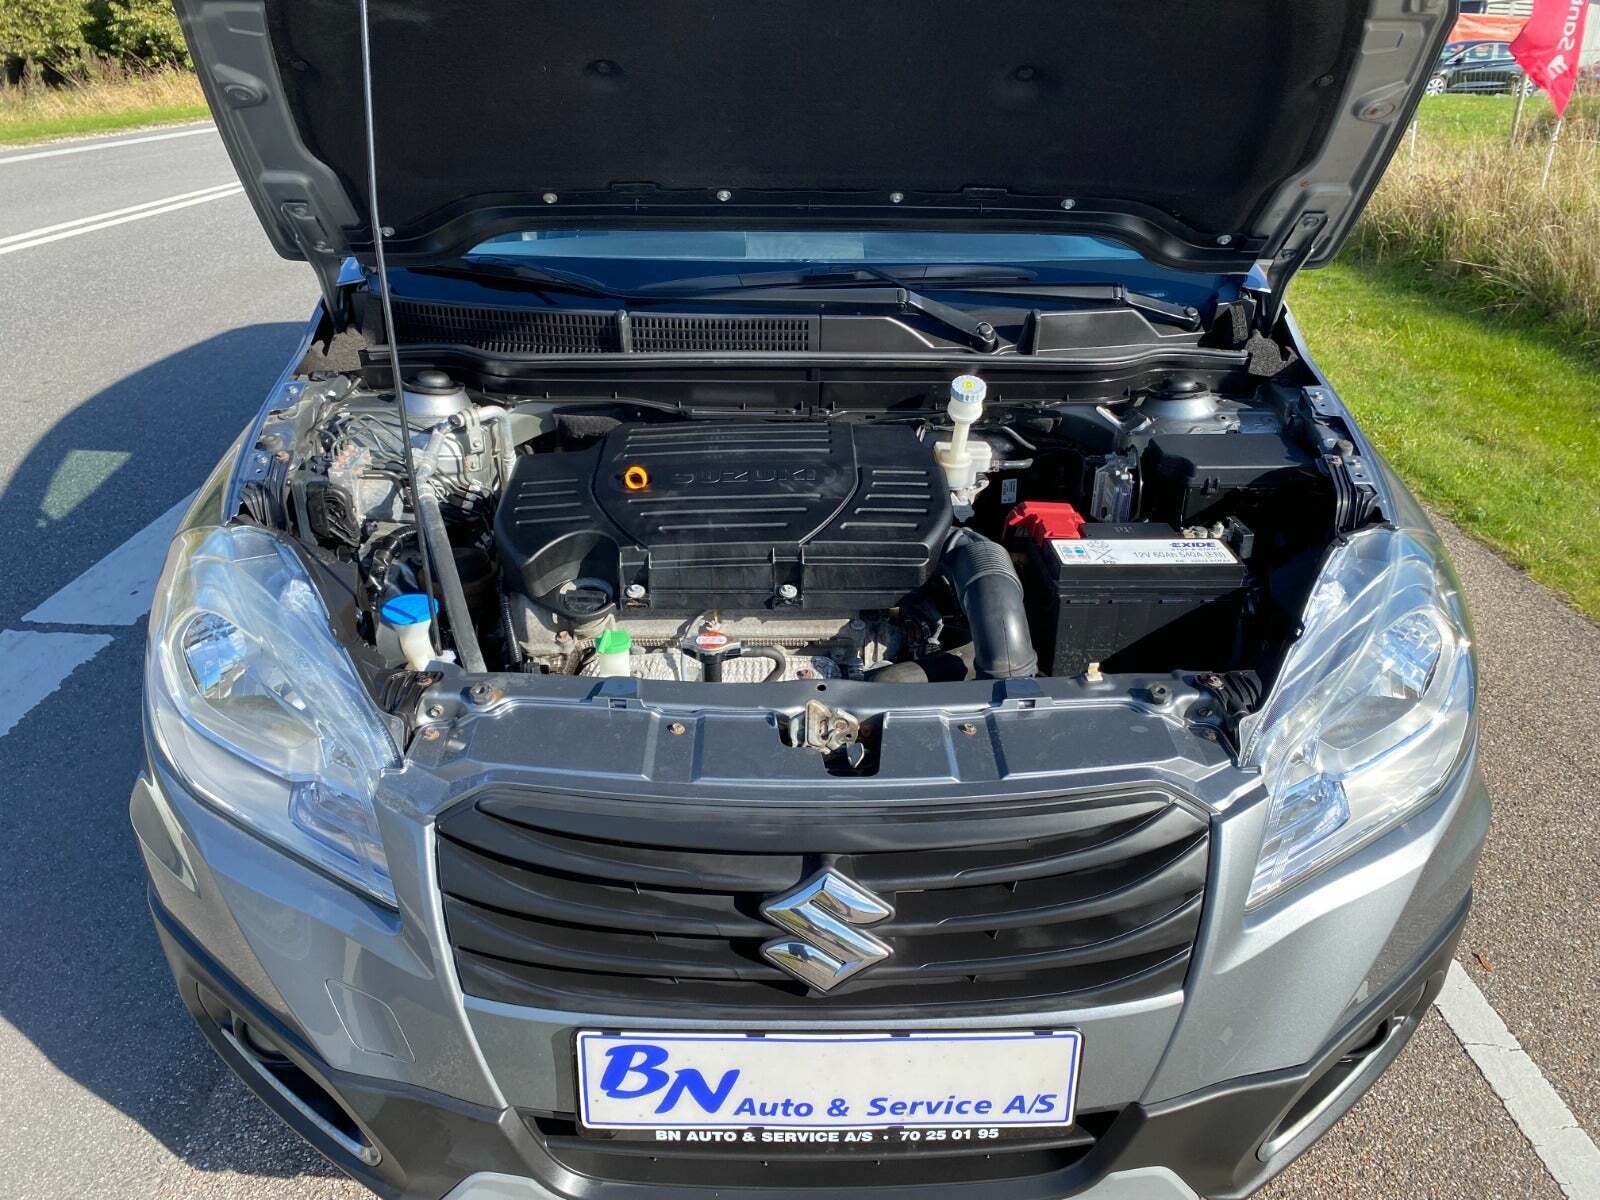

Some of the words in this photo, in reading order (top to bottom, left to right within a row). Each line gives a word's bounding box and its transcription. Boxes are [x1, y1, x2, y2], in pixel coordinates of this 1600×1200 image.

[600, 1044, 740, 1113] BN
[733, 1097, 814, 1117] Auto
[827, 1098, 850, 1117] &
[866, 1095, 993, 1117] Service
[1003, 1094, 1057, 1114] A/S
[655, 1130, 681, 1141] BN
[686, 1131, 737, 1142] AUTO
[742, 1131, 756, 1142] &
[761, 1131, 840, 1142] SERVICE
[844, 1131, 873, 1142] A/S
[900, 1131, 920, 1141] 70
[925, 1131, 947, 1141] 25
[951, 1130, 971, 1140] 01
[978, 1128, 999, 1139] 95
